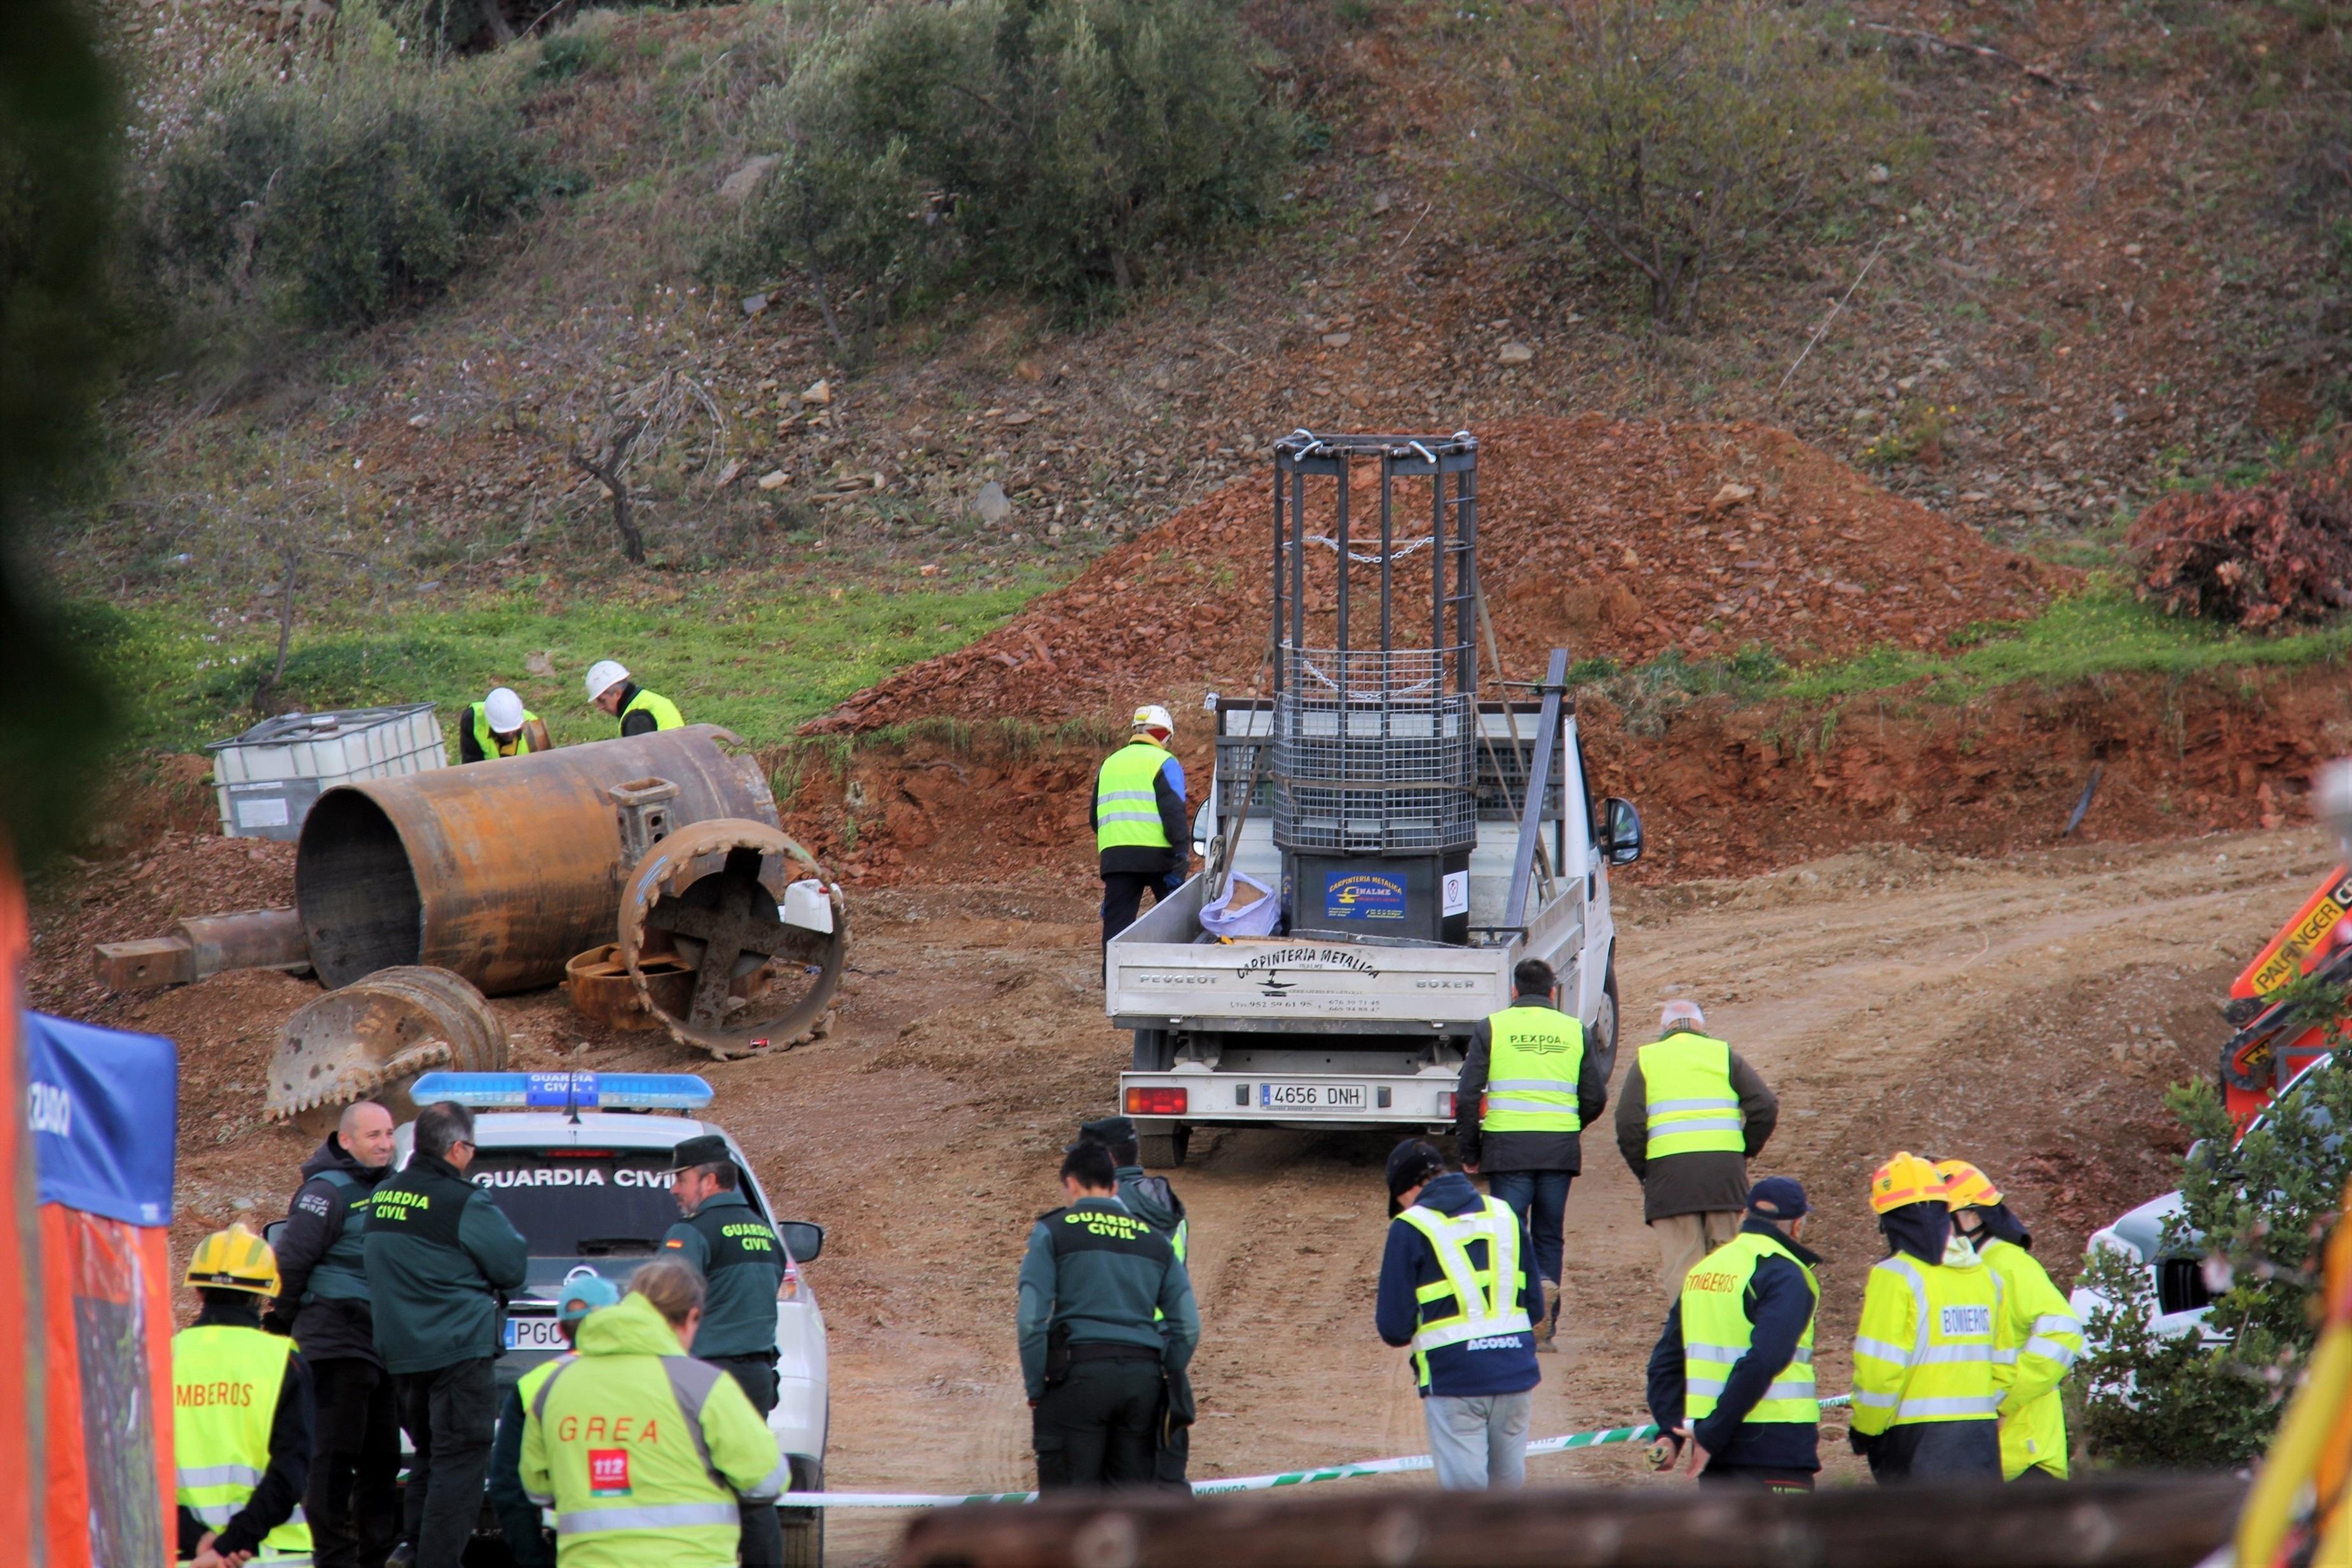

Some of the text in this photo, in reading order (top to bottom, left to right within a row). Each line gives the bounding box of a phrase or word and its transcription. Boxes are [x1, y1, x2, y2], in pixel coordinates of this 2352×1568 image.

[1329, 876, 1402, 895] CARPINTERIA METALICA
[1237, 948, 1316, 979] CARPINTERIA
[1140, 974, 1218, 984] PEUGEOT
[1416, 979, 1475, 988] BOXER
[1275, 1087, 1316, 1103] 4656
[1327, 1087, 1359, 1105] DNH
[471, 1168, 605, 1189] GUARDIA
[371, 1190, 429, 1210] GUARDIA
[376, 1204, 407, 1220] CIVIL
[1065, 1211, 1151, 1234] GUARDIA
[1088, 1222, 1137, 1240] CIVIL
[721, 1223, 776, 1241] GUARDIA
[741, 1237, 772, 1251] CIVIL
[1943, 1309, 1990, 1333] BOMBEROS
[1467, 1335, 1523, 1351] ACOSOL
[176, 1382, 254, 1407] MBEROS
[558, 1415, 658, 1445] GREA
[594, 1459, 624, 1475] 112
